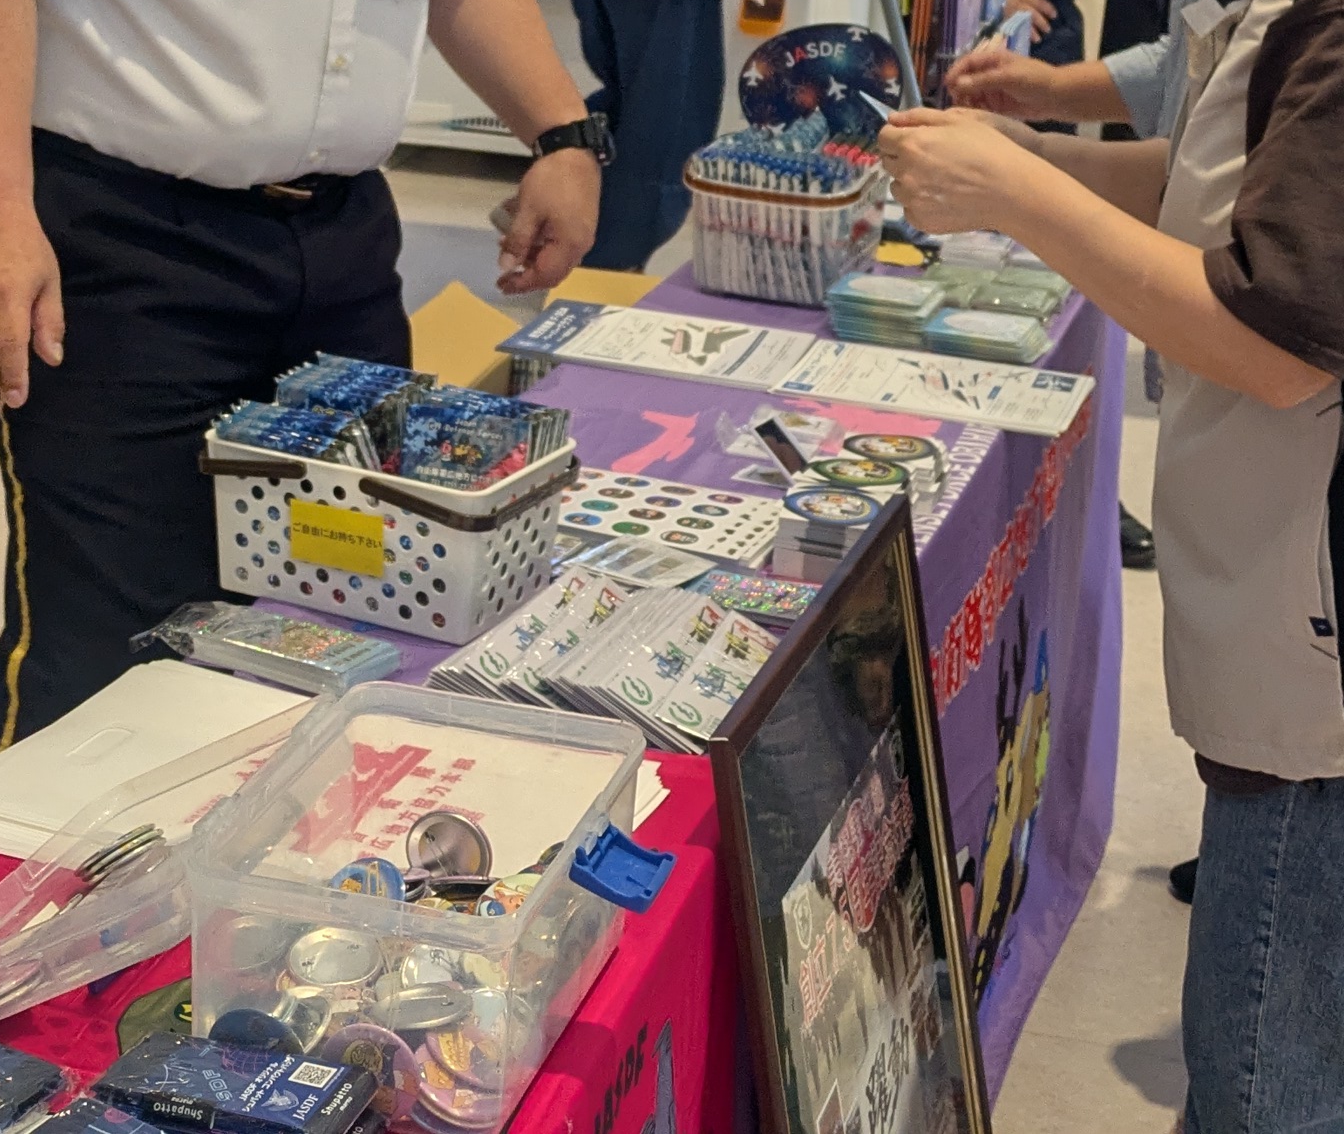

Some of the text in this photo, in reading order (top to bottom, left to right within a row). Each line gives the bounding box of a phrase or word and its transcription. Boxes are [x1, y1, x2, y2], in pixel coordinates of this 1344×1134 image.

[786, 40, 847, 68] JASDF
[292, 522, 383, 549] ご自由にお持ち下さい
[292, 1093, 319, 1122] JASDF
